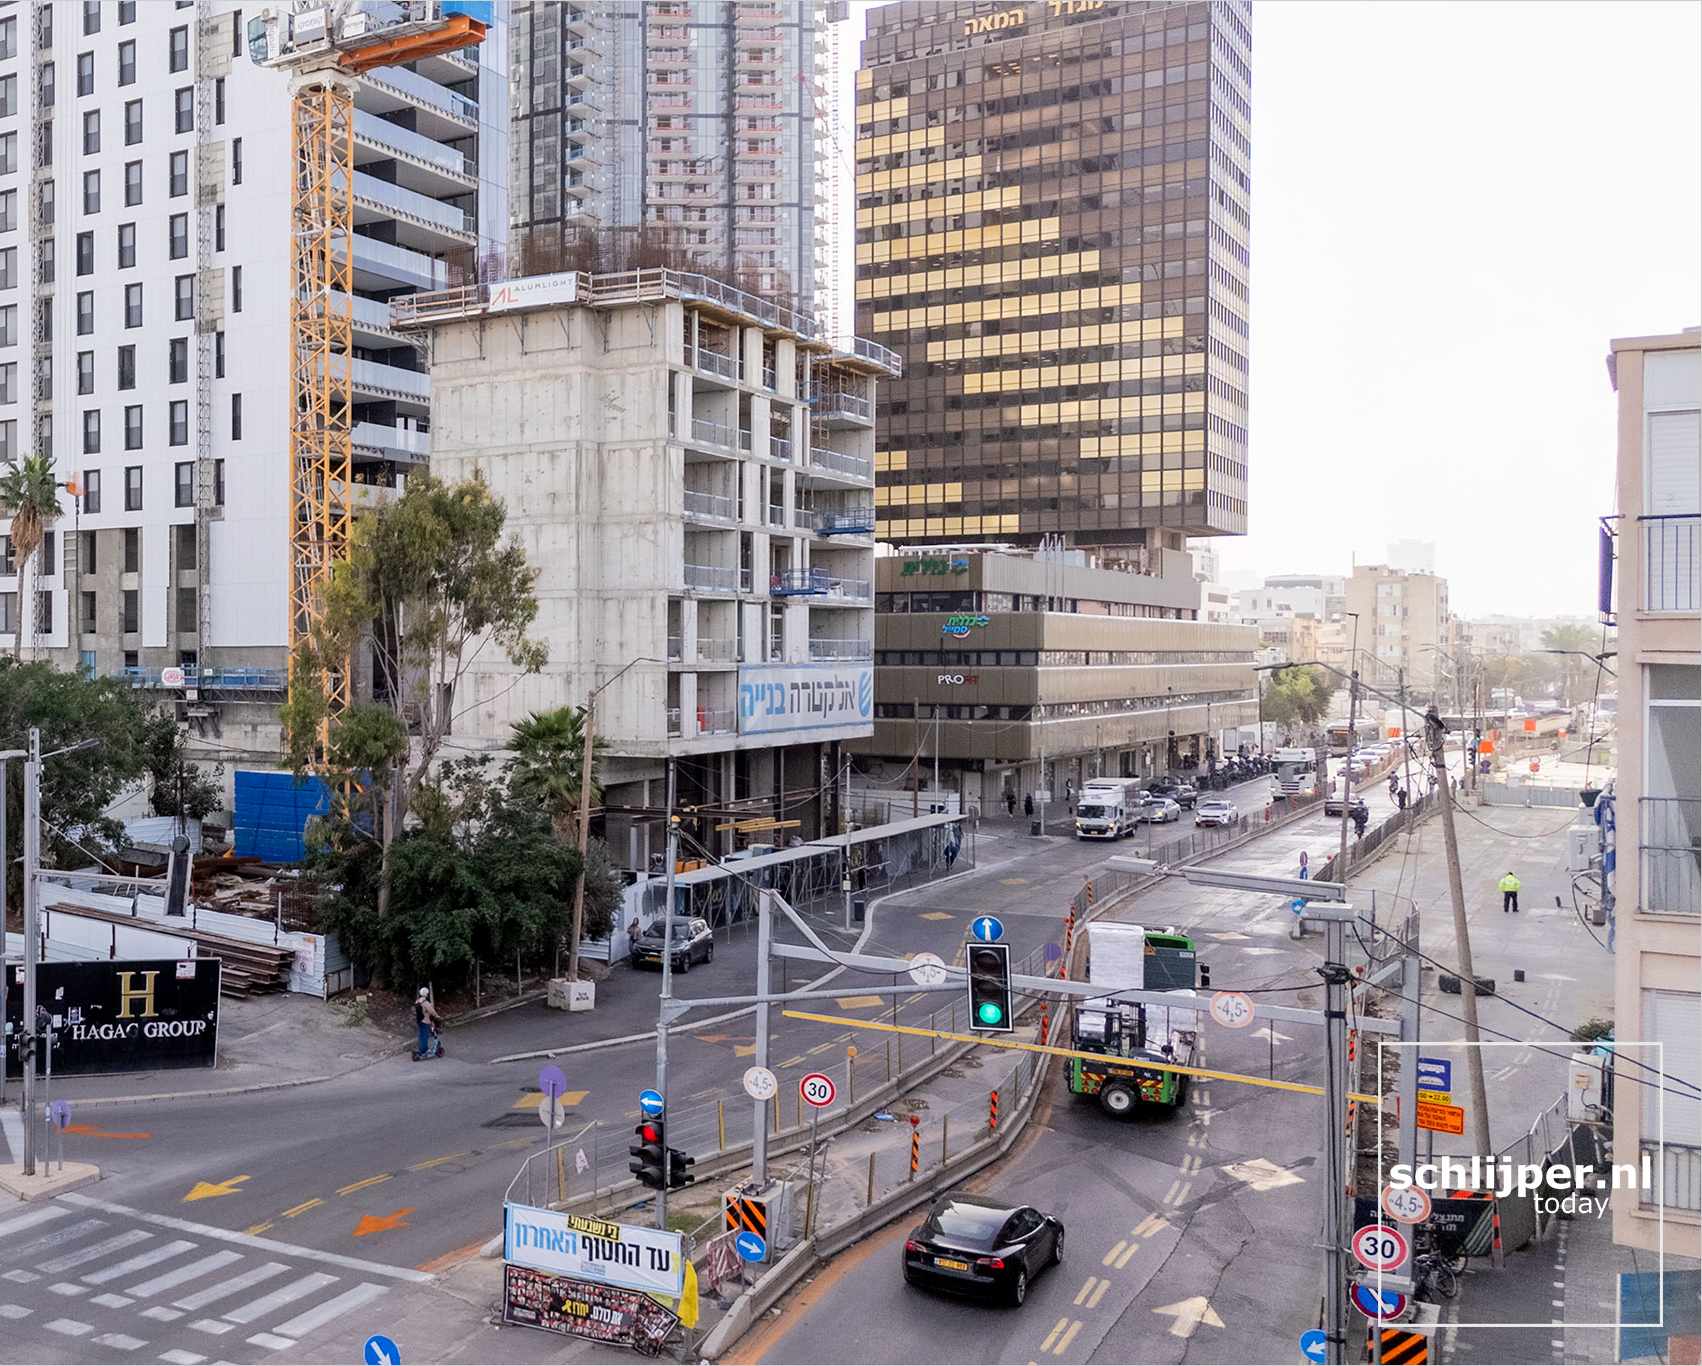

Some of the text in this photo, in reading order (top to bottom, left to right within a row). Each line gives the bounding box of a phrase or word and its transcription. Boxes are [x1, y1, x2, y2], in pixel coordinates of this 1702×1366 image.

[964, 8, 1025, 36] המאה
[514, 279, 574, 292] ALUMLIGHT
[740, 673, 856, 719] אלקטרה בנייה
[143, 1019, 206, 1038] GROUP
[808, 1082, 827, 1099] 30
[570, 1215, 607, 1236] נשבעתי
[514, 1223, 670, 1272] עד החטוף האחרון
[1364, 1236, 1396, 1259] 30
